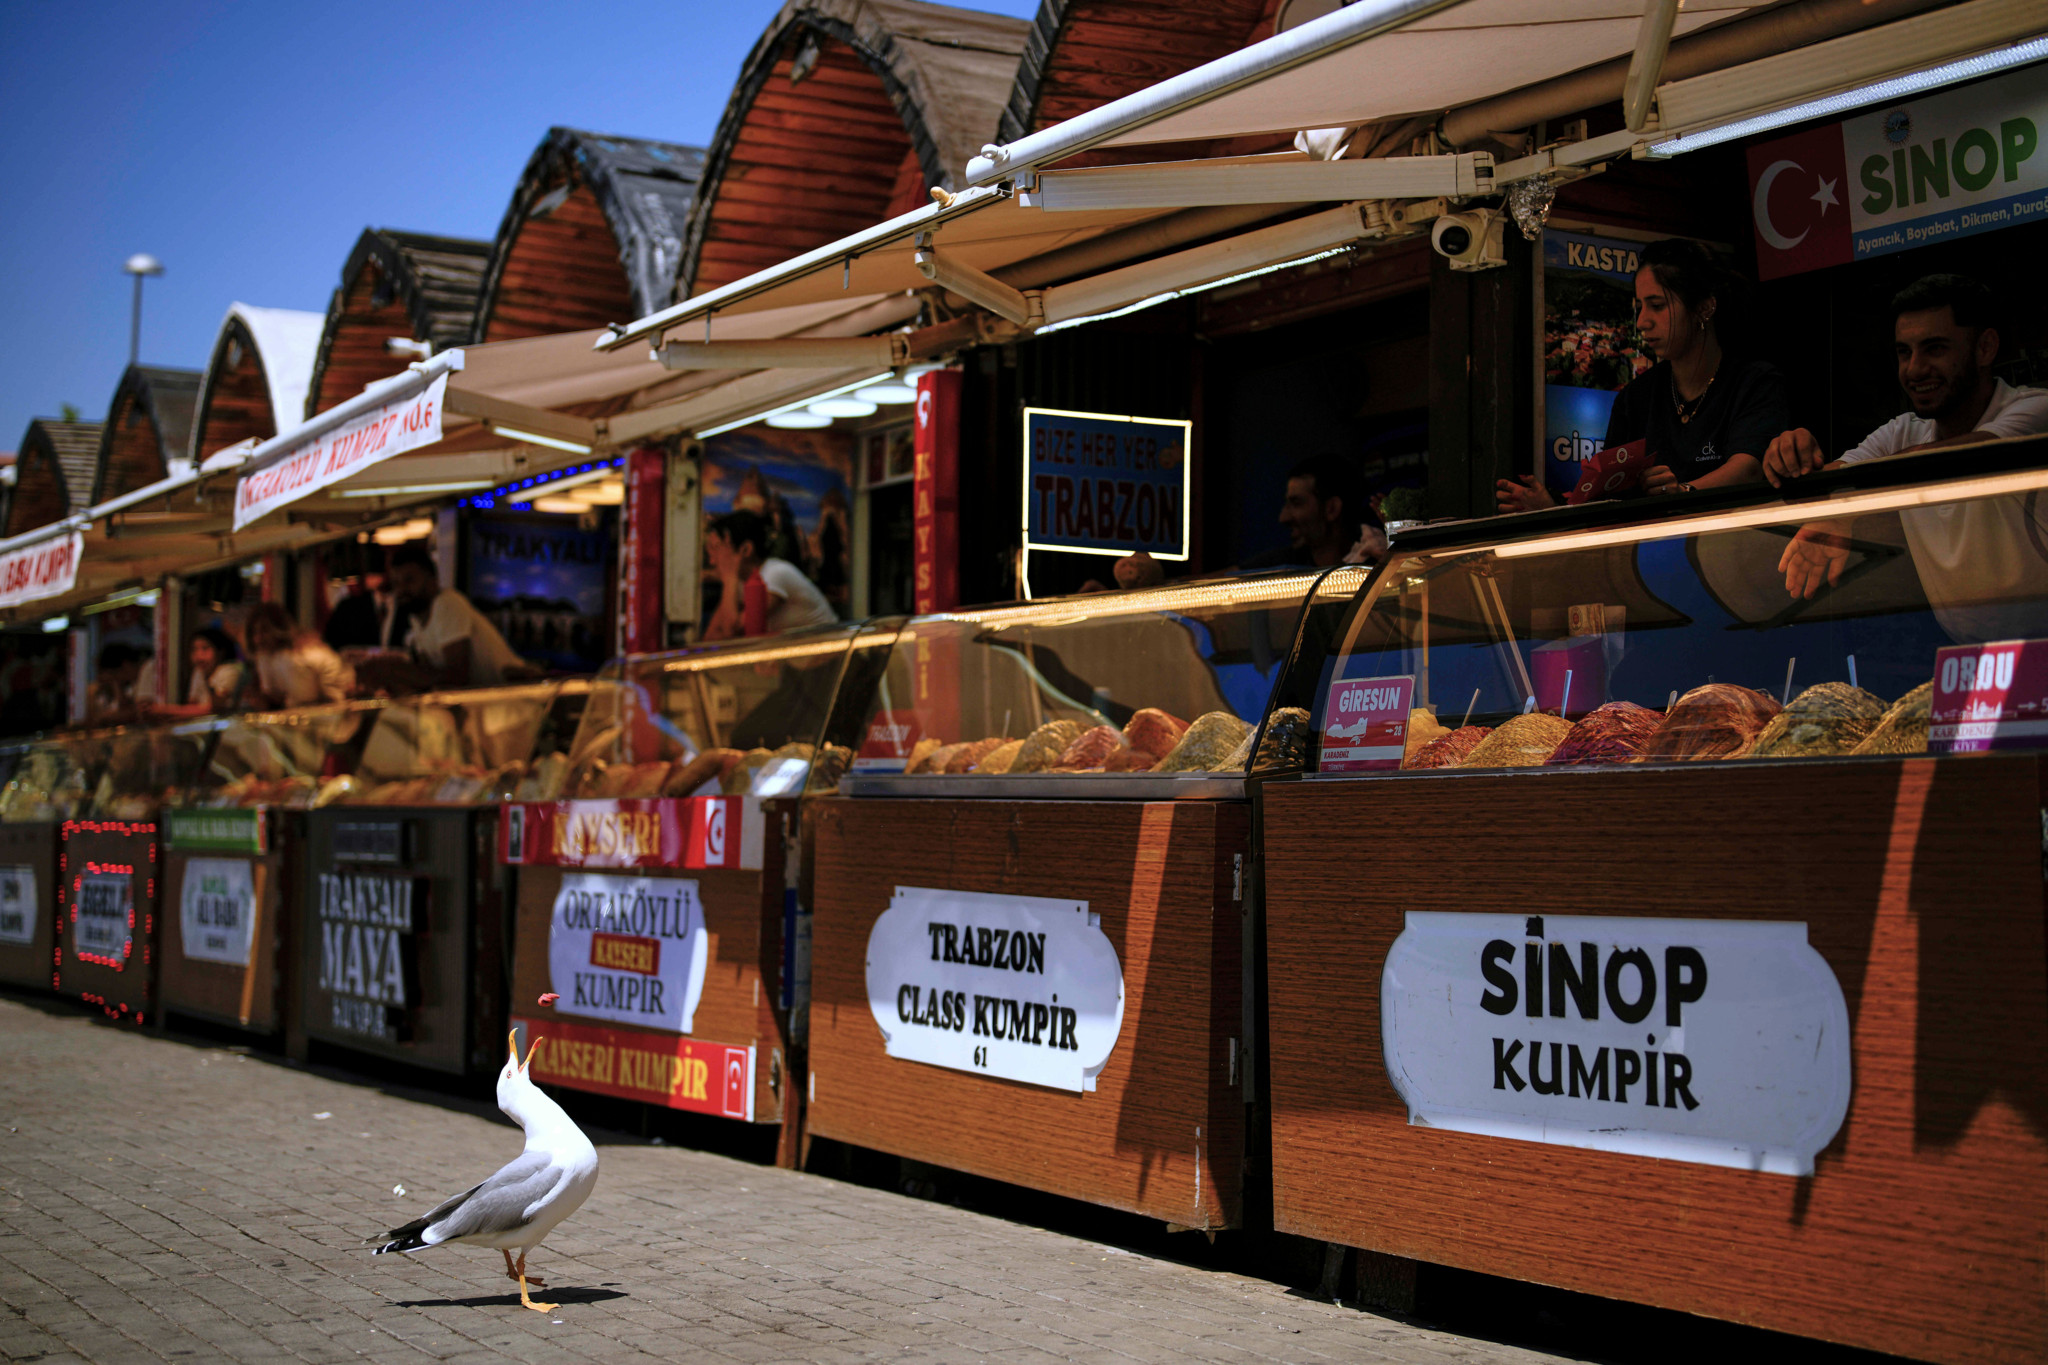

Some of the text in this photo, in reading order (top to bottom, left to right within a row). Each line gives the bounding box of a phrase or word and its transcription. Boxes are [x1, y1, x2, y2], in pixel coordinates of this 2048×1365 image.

[1906, 220, 1959, 241] Boyabat,
[1961, 207, 2011, 229] Dikmen,
[1081, 432, 1117, 467] HER
[1122, 434, 1158, 471] YER
[1034, 474, 1180, 545] TRABZON
[1941, 651, 2015, 694] ORDU
[1339, 682, 1401, 713] GİRESUN
[563, 887, 691, 940] ORTAKÖYLÜ
[928, 922, 1046, 975] TRABZON
[574, 968, 666, 1014] KUMPİR
[897, 984, 1078, 1051] CLASS KUMPİR
[617, 1045, 709, 1101] KUMPİR
[974, 1045, 988, 1067] 61
[1493, 1033, 1700, 1111] KUMPİR
